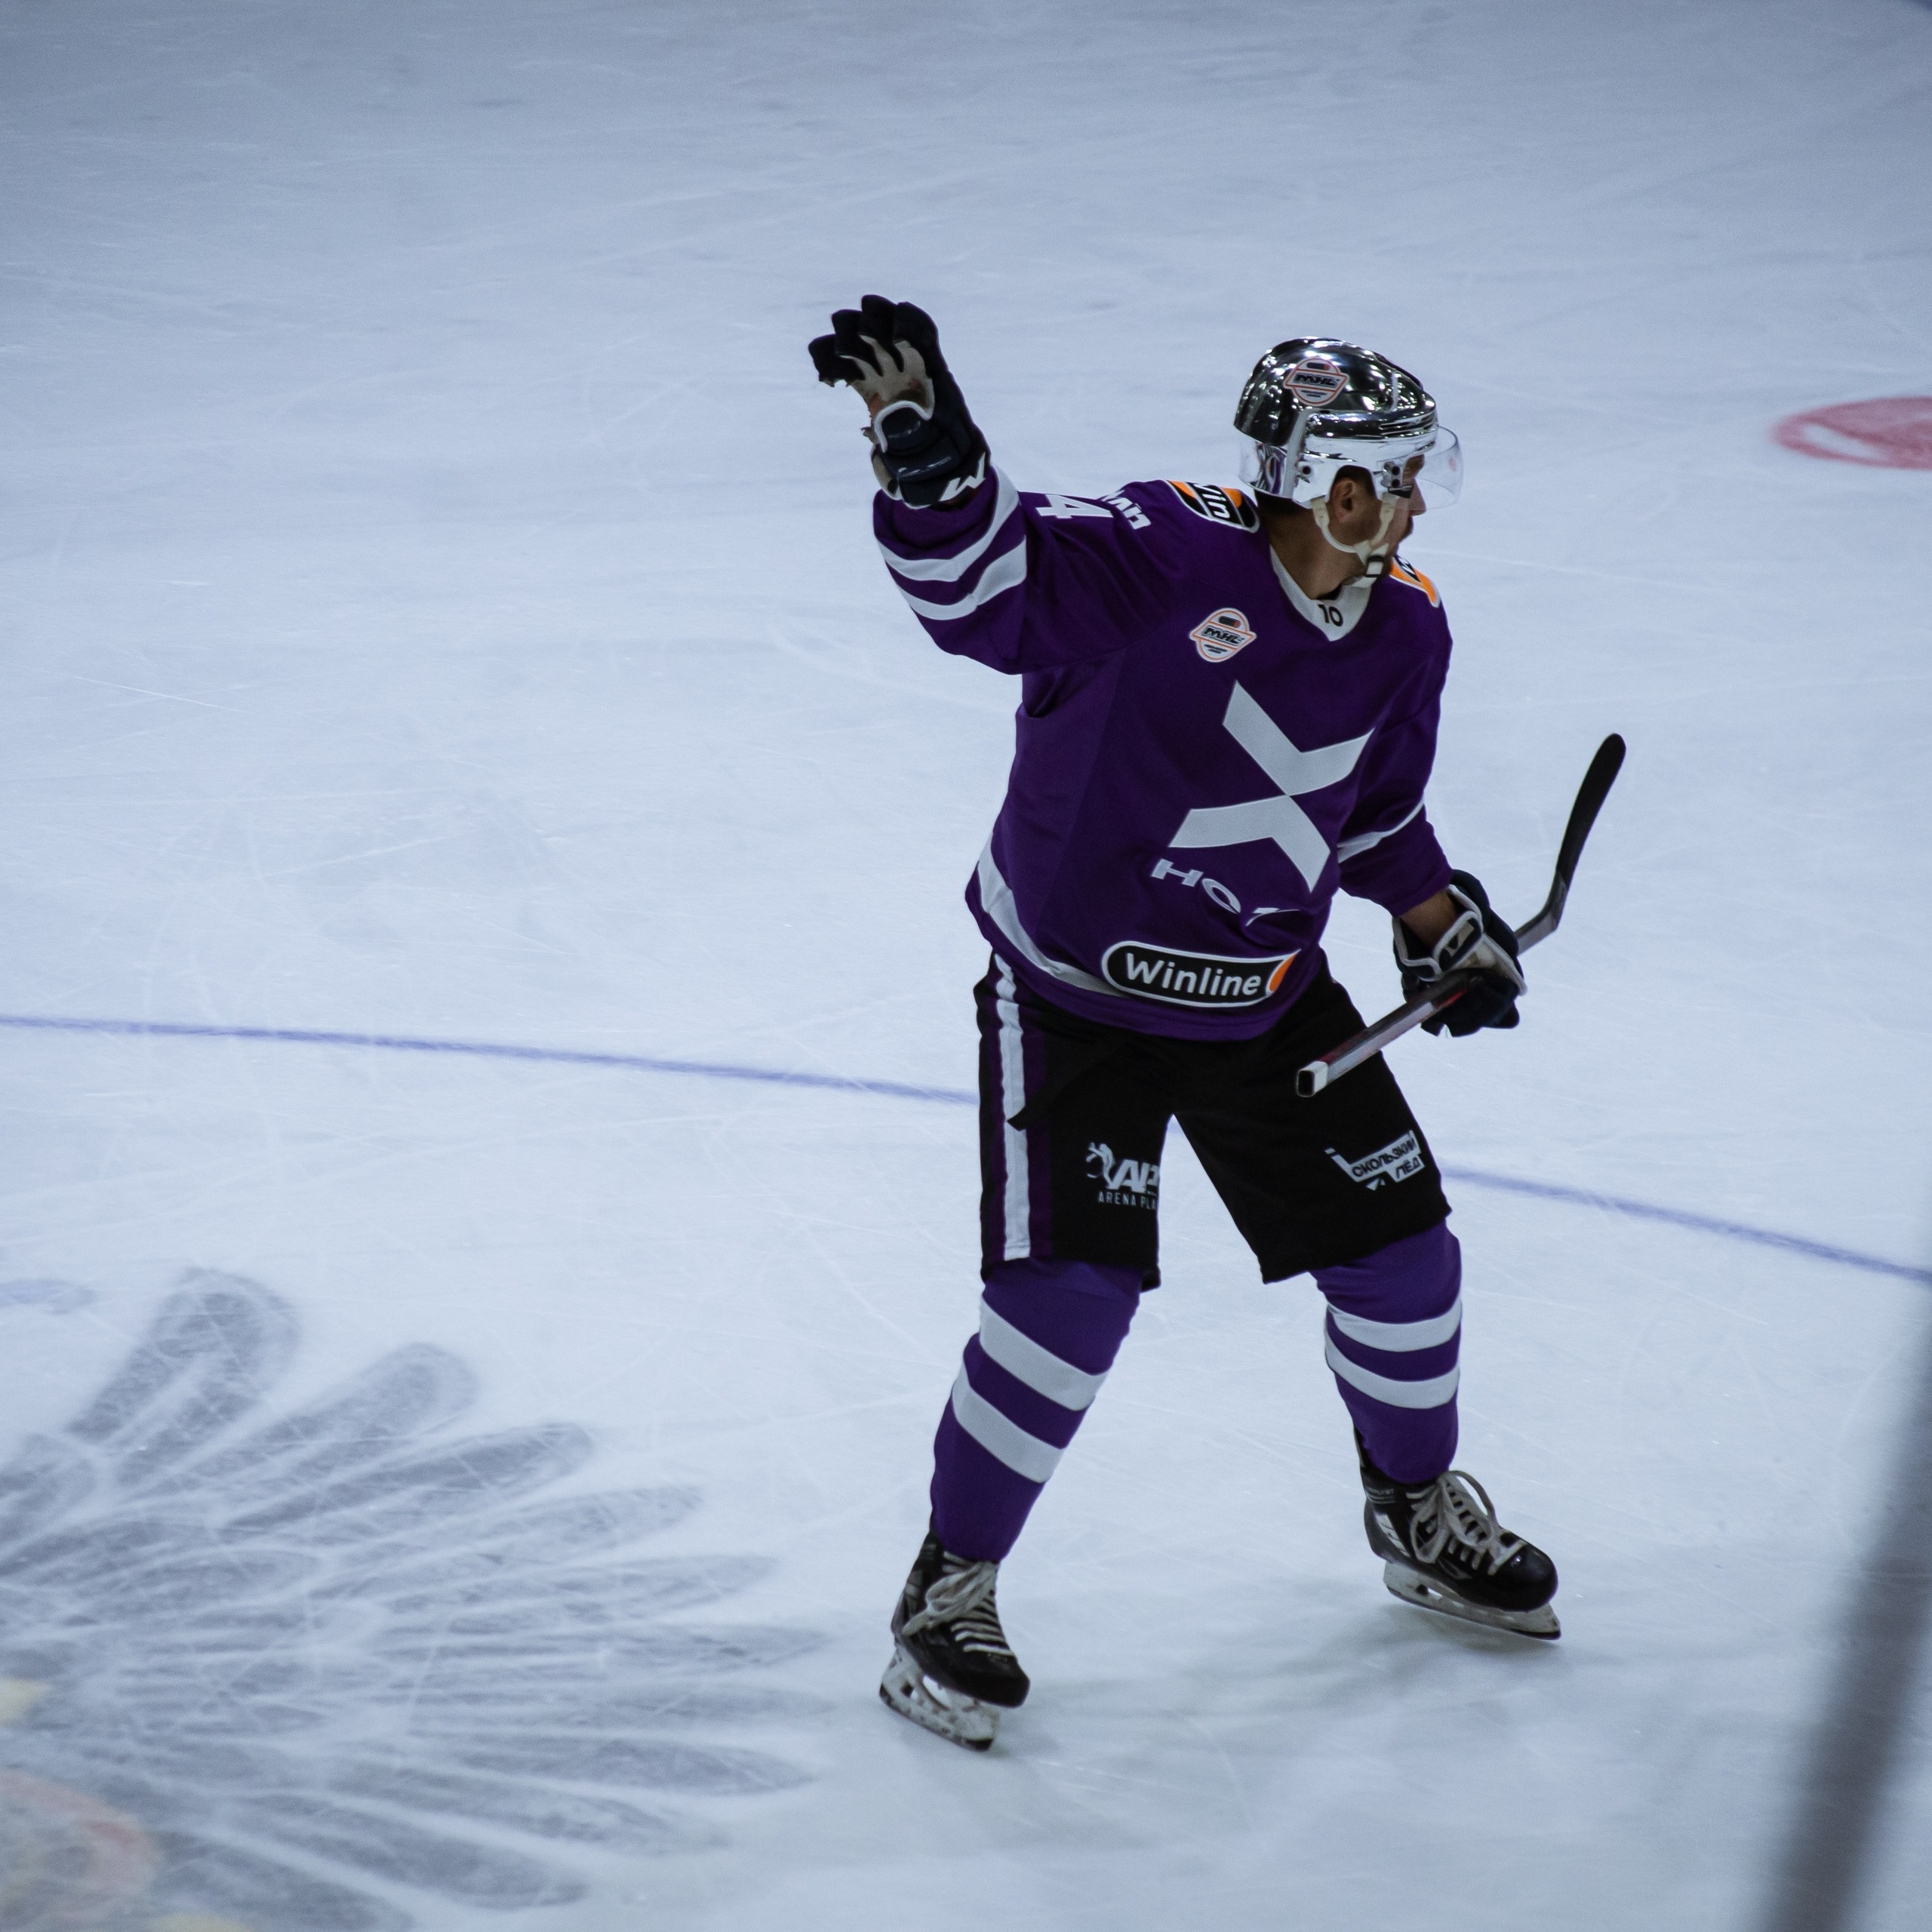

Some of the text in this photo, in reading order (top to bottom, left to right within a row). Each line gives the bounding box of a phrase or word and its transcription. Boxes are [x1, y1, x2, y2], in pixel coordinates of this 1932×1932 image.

[1318, 604, 1343, 626] 10
[1125, 952, 1262, 996] Winline
[1098, 1192, 1137, 1206] ARENA
